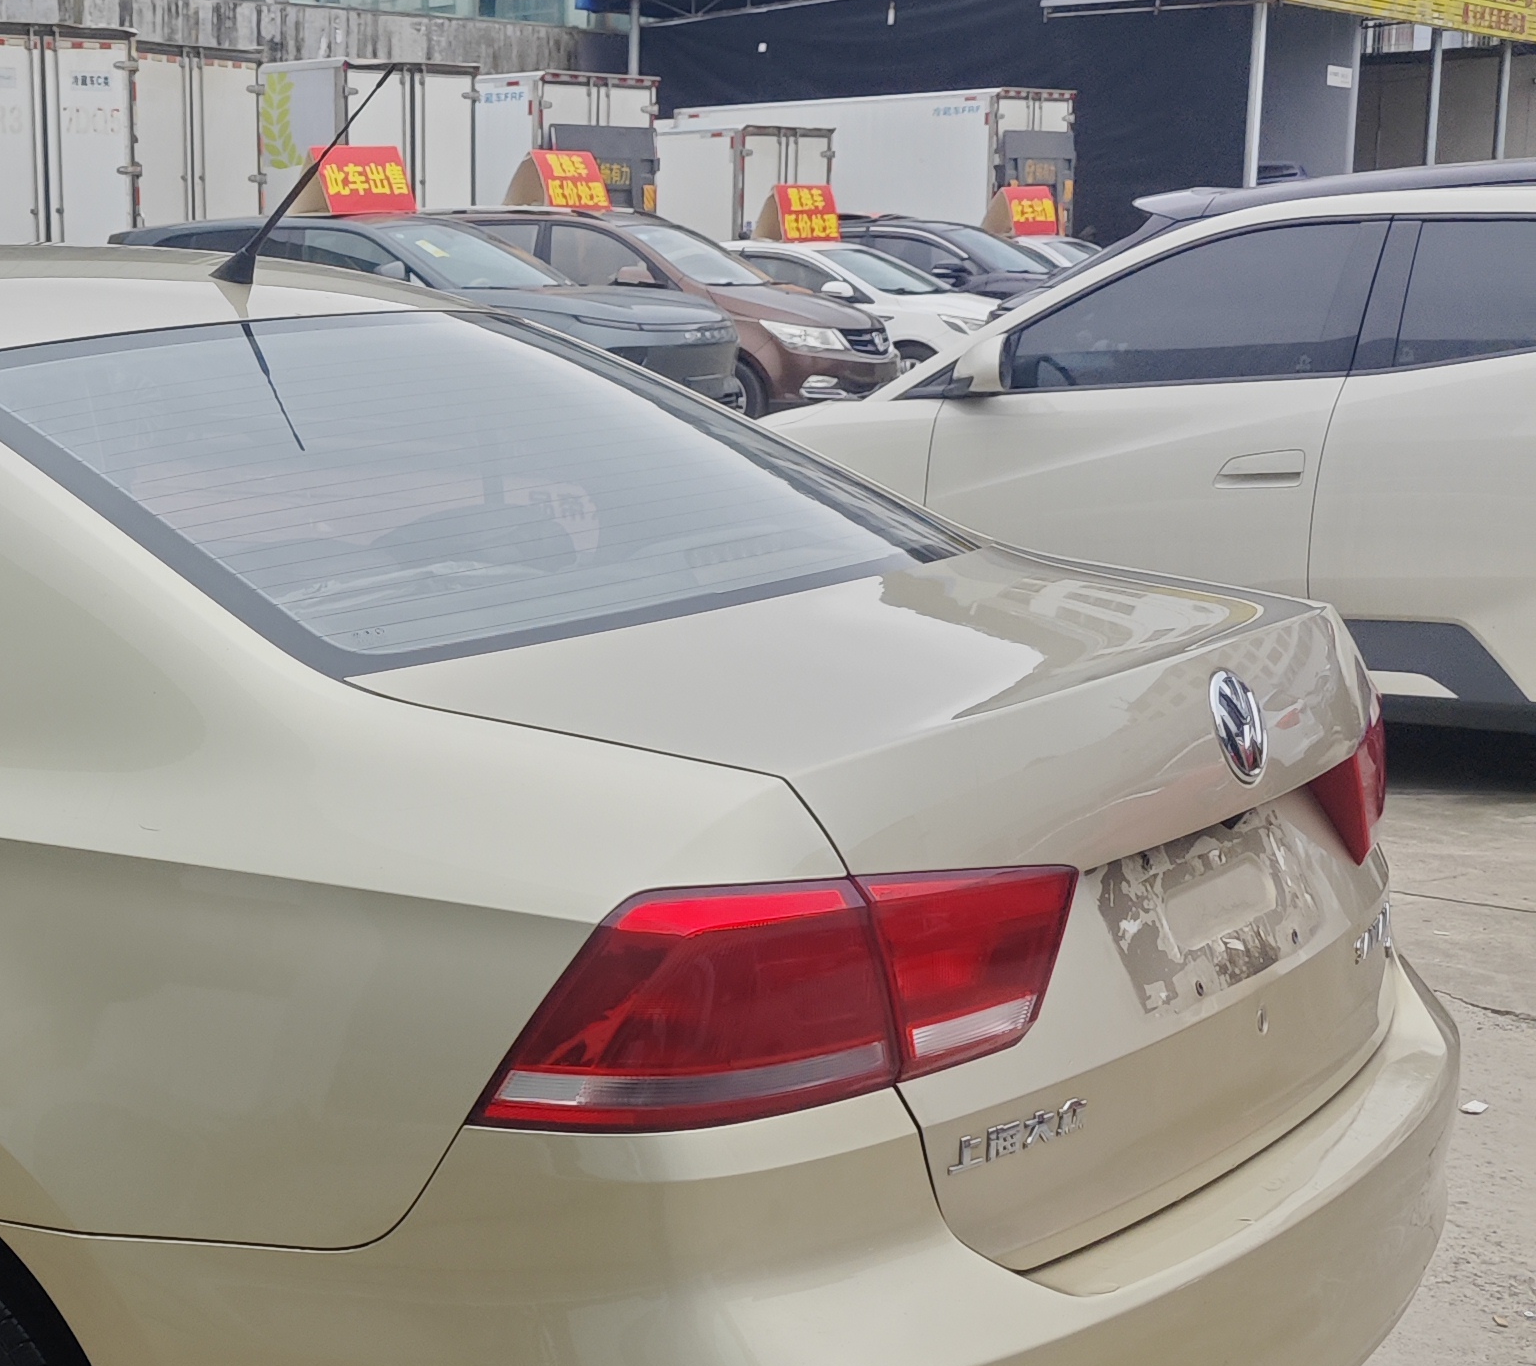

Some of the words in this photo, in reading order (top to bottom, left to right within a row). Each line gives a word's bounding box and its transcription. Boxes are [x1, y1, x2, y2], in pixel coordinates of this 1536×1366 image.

[324, 162, 409, 195] 此车出售
[546, 153, 590, 177] 置换车
[548, 179, 609, 207] 低价处理
[785, 214, 839, 239] 低价处理
[948, 1098, 1088, 1175] 上海大众
